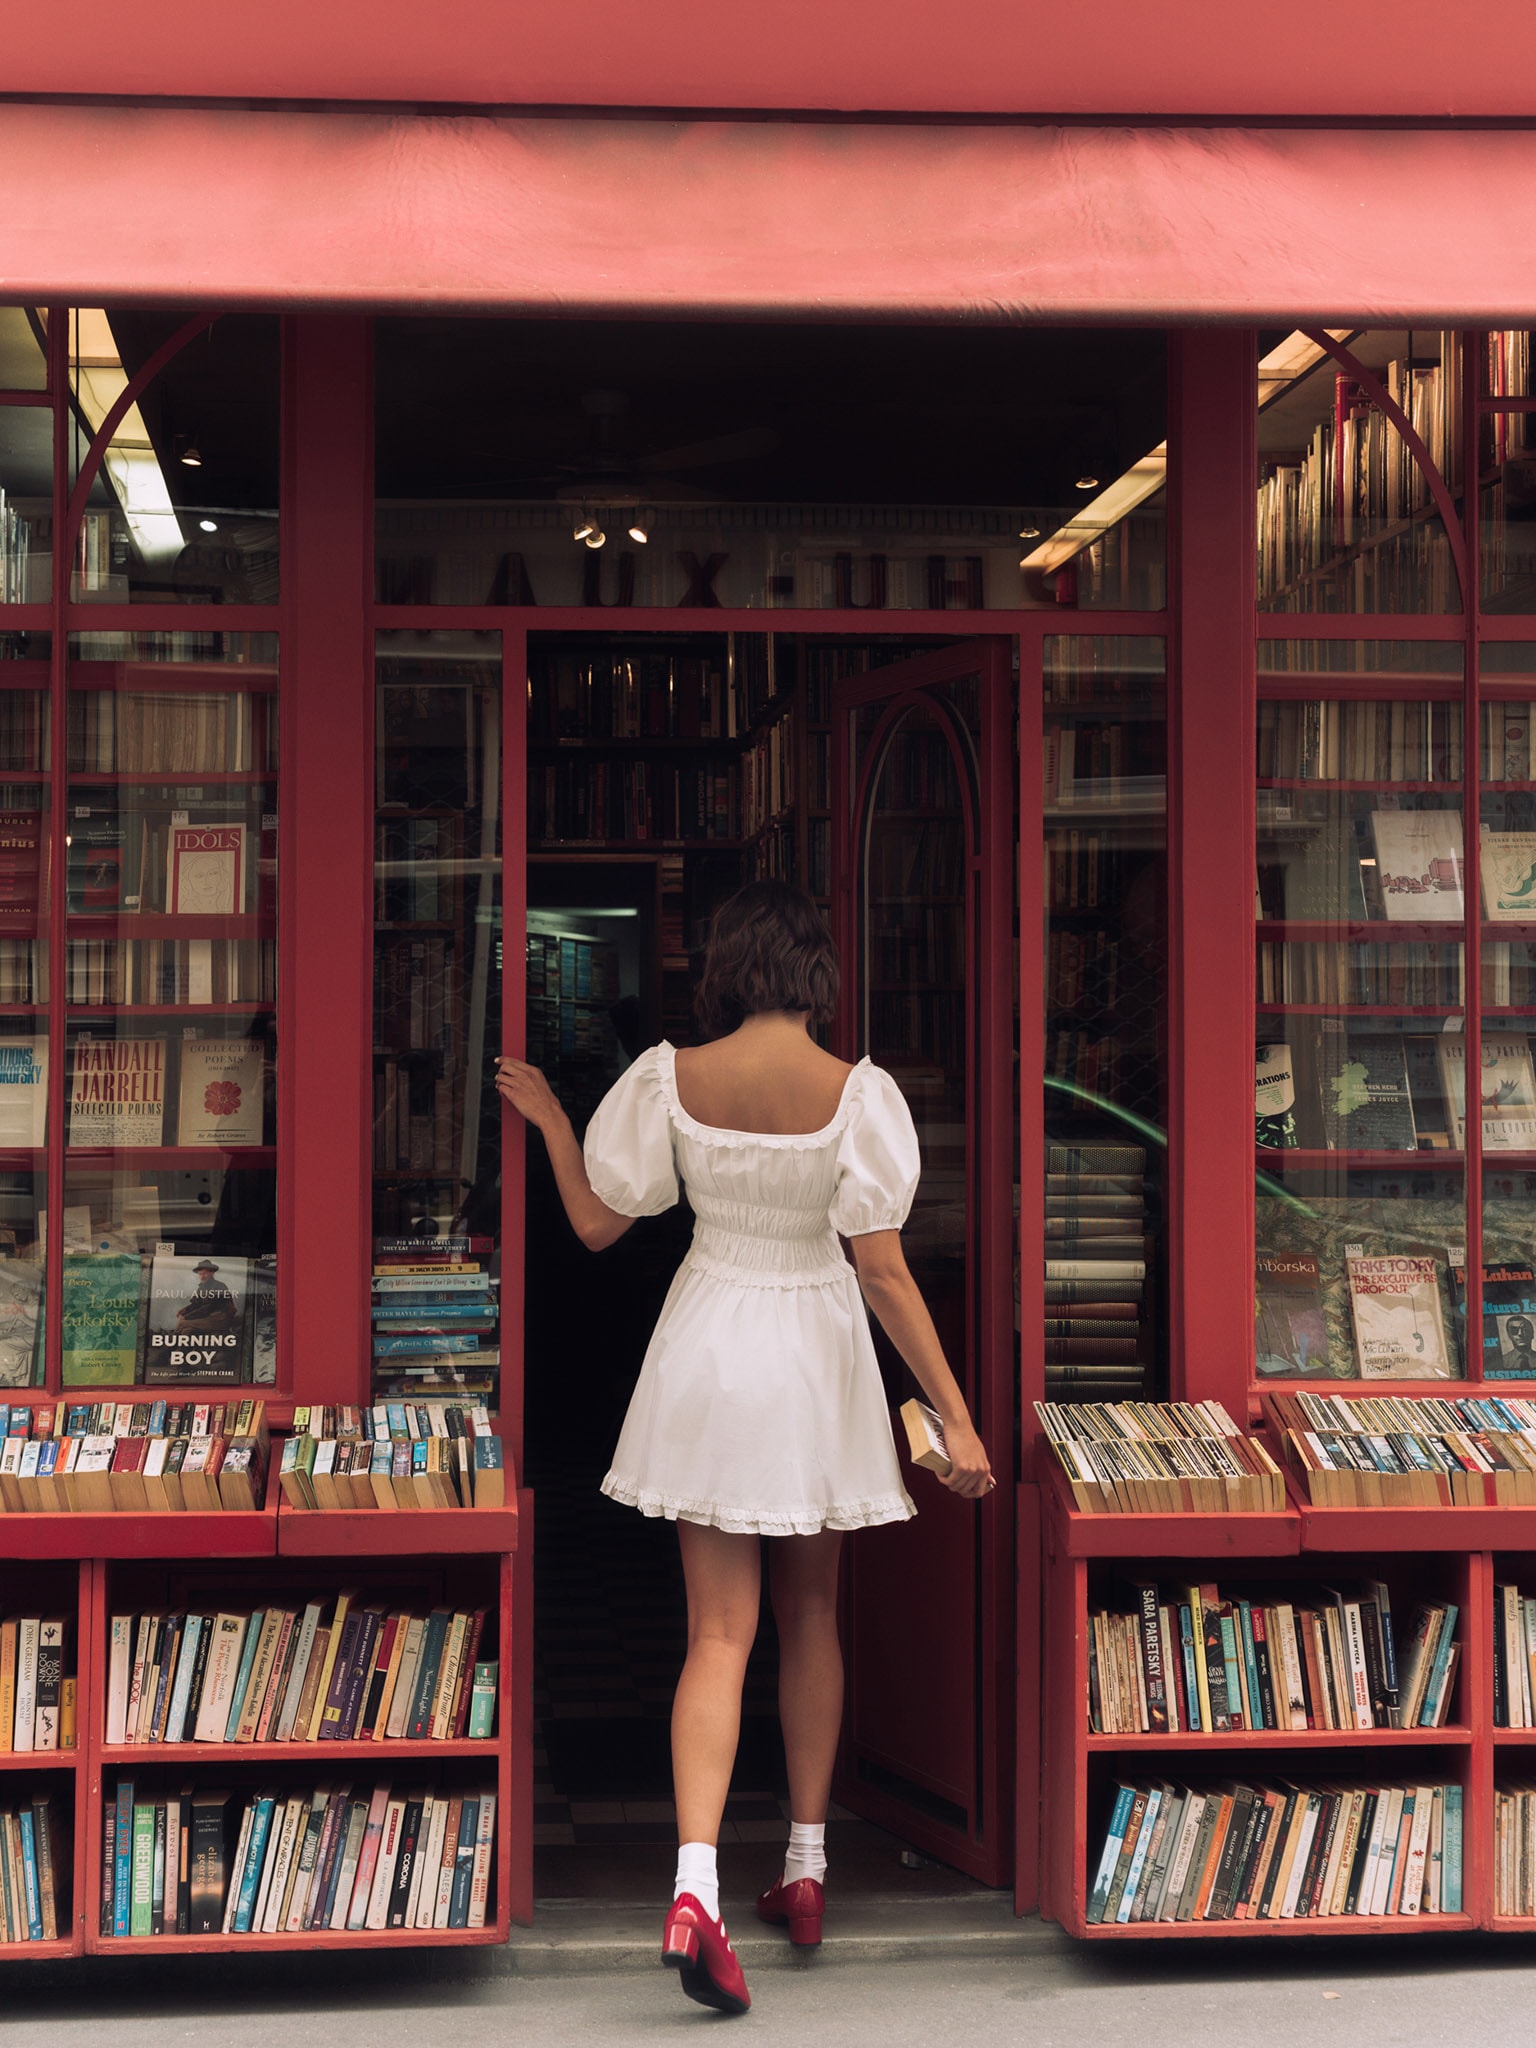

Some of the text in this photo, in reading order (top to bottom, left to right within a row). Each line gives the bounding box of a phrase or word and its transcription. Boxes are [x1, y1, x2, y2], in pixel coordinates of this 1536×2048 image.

[176, 832, 241, 849] IDOLS
[77, 1041, 163, 1072] RANDALL
[189, 1044, 260, 1054] COLLECTED
[205, 1055, 244, 1064] POEMS
[76, 1072, 162, 1103] JARRELL
[73, 1102, 162, 1116] SELECTED POEMS
[1351, 1259, 1435, 1273] TAKE TODAY
[1454, 1266, 1534, 1284] MLuhan
[1352, 1274, 1437, 1285] THE EXECUTIVE AS
[1355, 1284, 1408, 1295] DROPOUT
[90, 1294, 136, 1309] Louis
[155, 1289, 240, 1299] PAUL AUSTER
[61, 1312, 135, 1331] Zukofsky
[151, 1334, 237, 1347] BURNING
[1363, 1345, 1404, 1354] McLuhan
[170, 1350, 217, 1365] BOY
[139, 1621, 148, 1636] Gary
[341, 1619, 357, 1660] BUNKER
[363, 1615, 373, 1640] DOROTHY
[473, 1618, 481, 1636] ANITA
[1142, 1589, 1161, 1676] SARA PARETSKY
[24, 1624, 34, 1681] JOHN GRISHAM
[263, 1634, 274, 1649] Trilogy
[358, 1640, 368, 1666] DUNNETT
[1287, 1637, 1296, 1660] Known
[1352, 1637, 1360, 1665] LEWYCKA
[39, 1653, 47, 1682] DOWN
[133, 1661, 143, 1676] The
[214, 1639, 227, 1672] The Pope's
[257, 1656, 268, 1680] Alexander
[45, 1660, 54, 1688] GONE
[52, 1659, 60, 1682] MAN
[217, 1639, 235, 1701] Lawrence Norfolk
[444, 1655, 458, 1689] Charlotte
[1291, 1663, 1299, 1683] World
[418, 1668, 433, 1716] Northern Lights
[1149, 1682, 1157, 1698] KANSAS
[1155, 1679, 1164, 1700] BLEEDING
[2, 1684, 11, 1734] Andrea Levy
[39, 1807, 48, 1833] WILLIAM
[118, 1788, 131, 1857] GEOFF DYER
[1201, 1801, 1213, 1830] ARDEN
[168, 1818, 178, 1858] harvest
[276, 1818, 294, 1879] TENT OF MIRACLES
[478, 1802, 491, 1873] THE MAN FROM BEIJING
[1313, 1796, 1341, 1900] MOTHERING SUNDAY GRAHAM SWIFT
[1342, 1815, 1356, 1862] LEVIATHAN
[302, 1835, 318, 1867] DUNBAR
[399, 1837, 414, 1889] RED CORONA
[441, 1831, 456, 1893] TELLING TALES
[1172, 1823, 1193, 1890] NATHAN ENGLANDER
[1224, 1855, 1232, 1870] CITY
[41, 1851, 49, 1880] KRUEGER
[135, 1833, 152, 1904] GREENWOOD
[196, 1853, 207, 1888] george
[479, 1878, 487, 1902] HENNING
[1407, 1873, 1416, 1895] Noon
[1413, 1865, 1423, 1897] Red Sky
